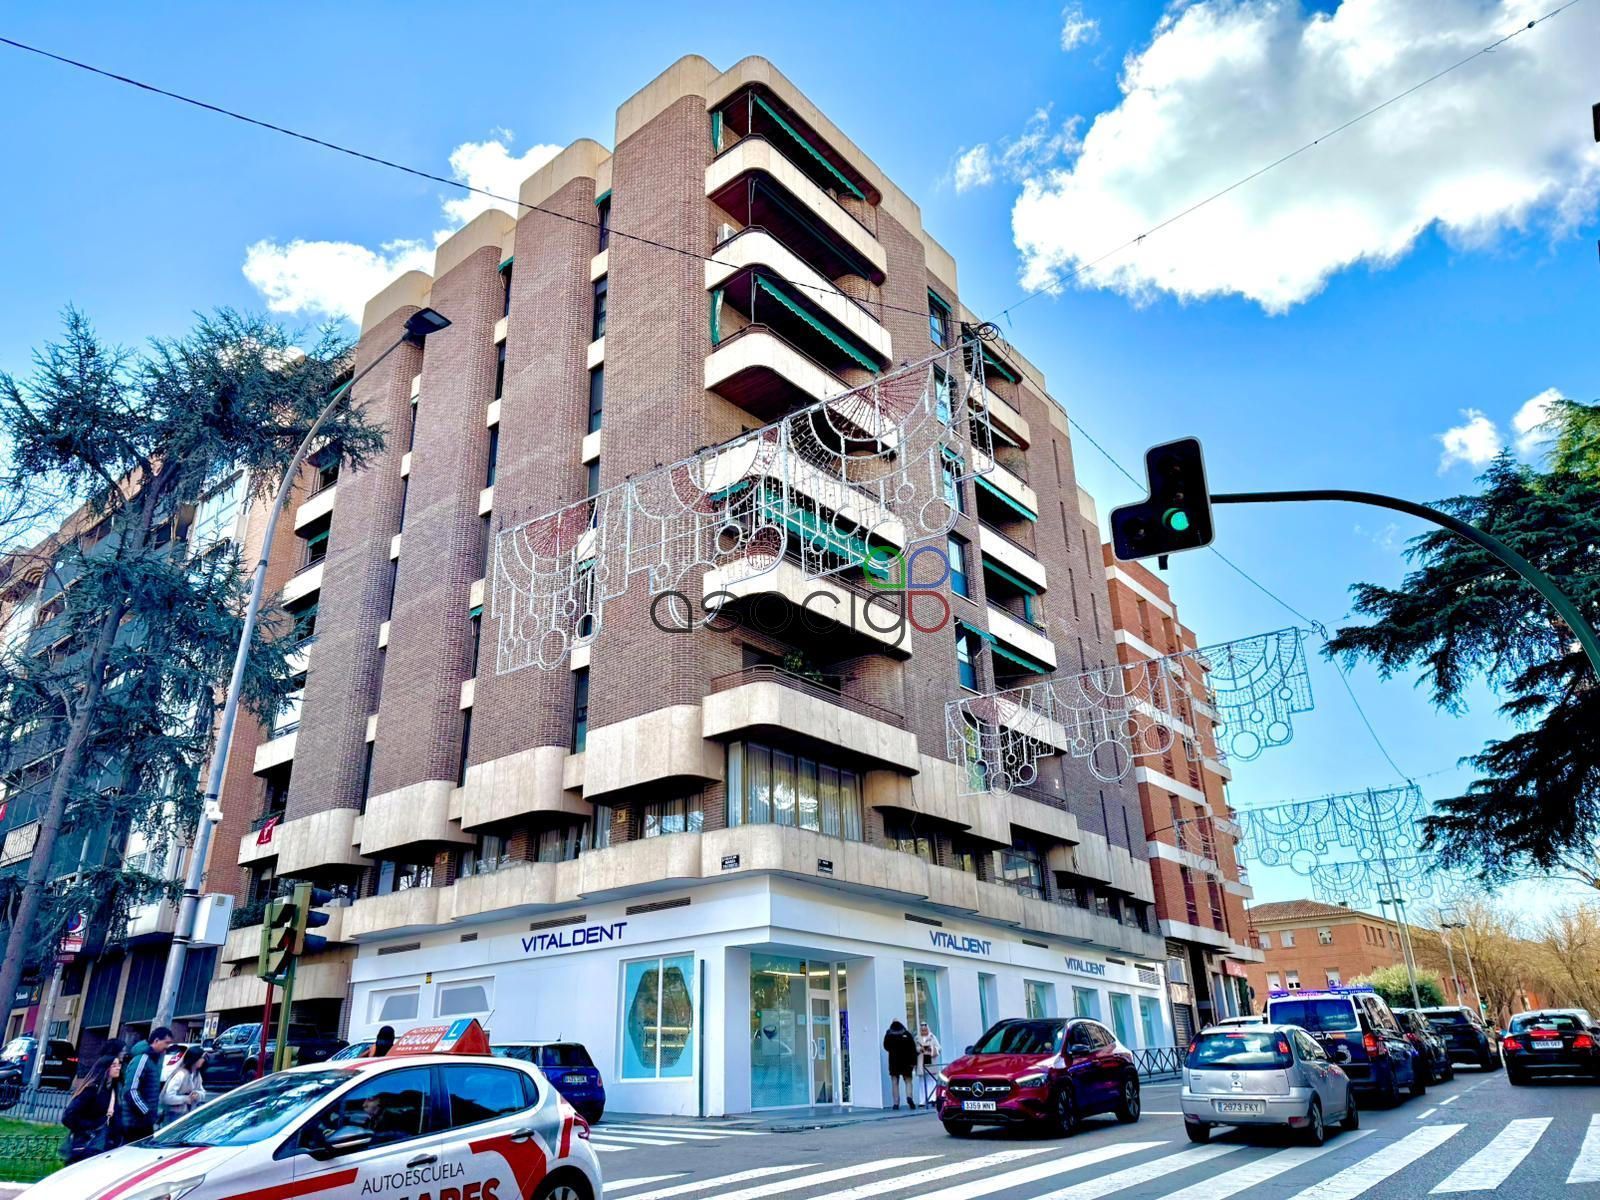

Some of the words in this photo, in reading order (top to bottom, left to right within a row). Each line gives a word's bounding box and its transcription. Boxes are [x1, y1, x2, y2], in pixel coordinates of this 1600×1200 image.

[521, 922, 628, 953] VITALDENT
[929, 930, 992, 956] VITALDENT
[1064, 956, 1106, 977] VITALDENT
[447, 1022, 461, 1038] L
[1244, 1103, 1259, 1112] FKY
[361, 1162, 465, 1196] AUTOESCUELA
